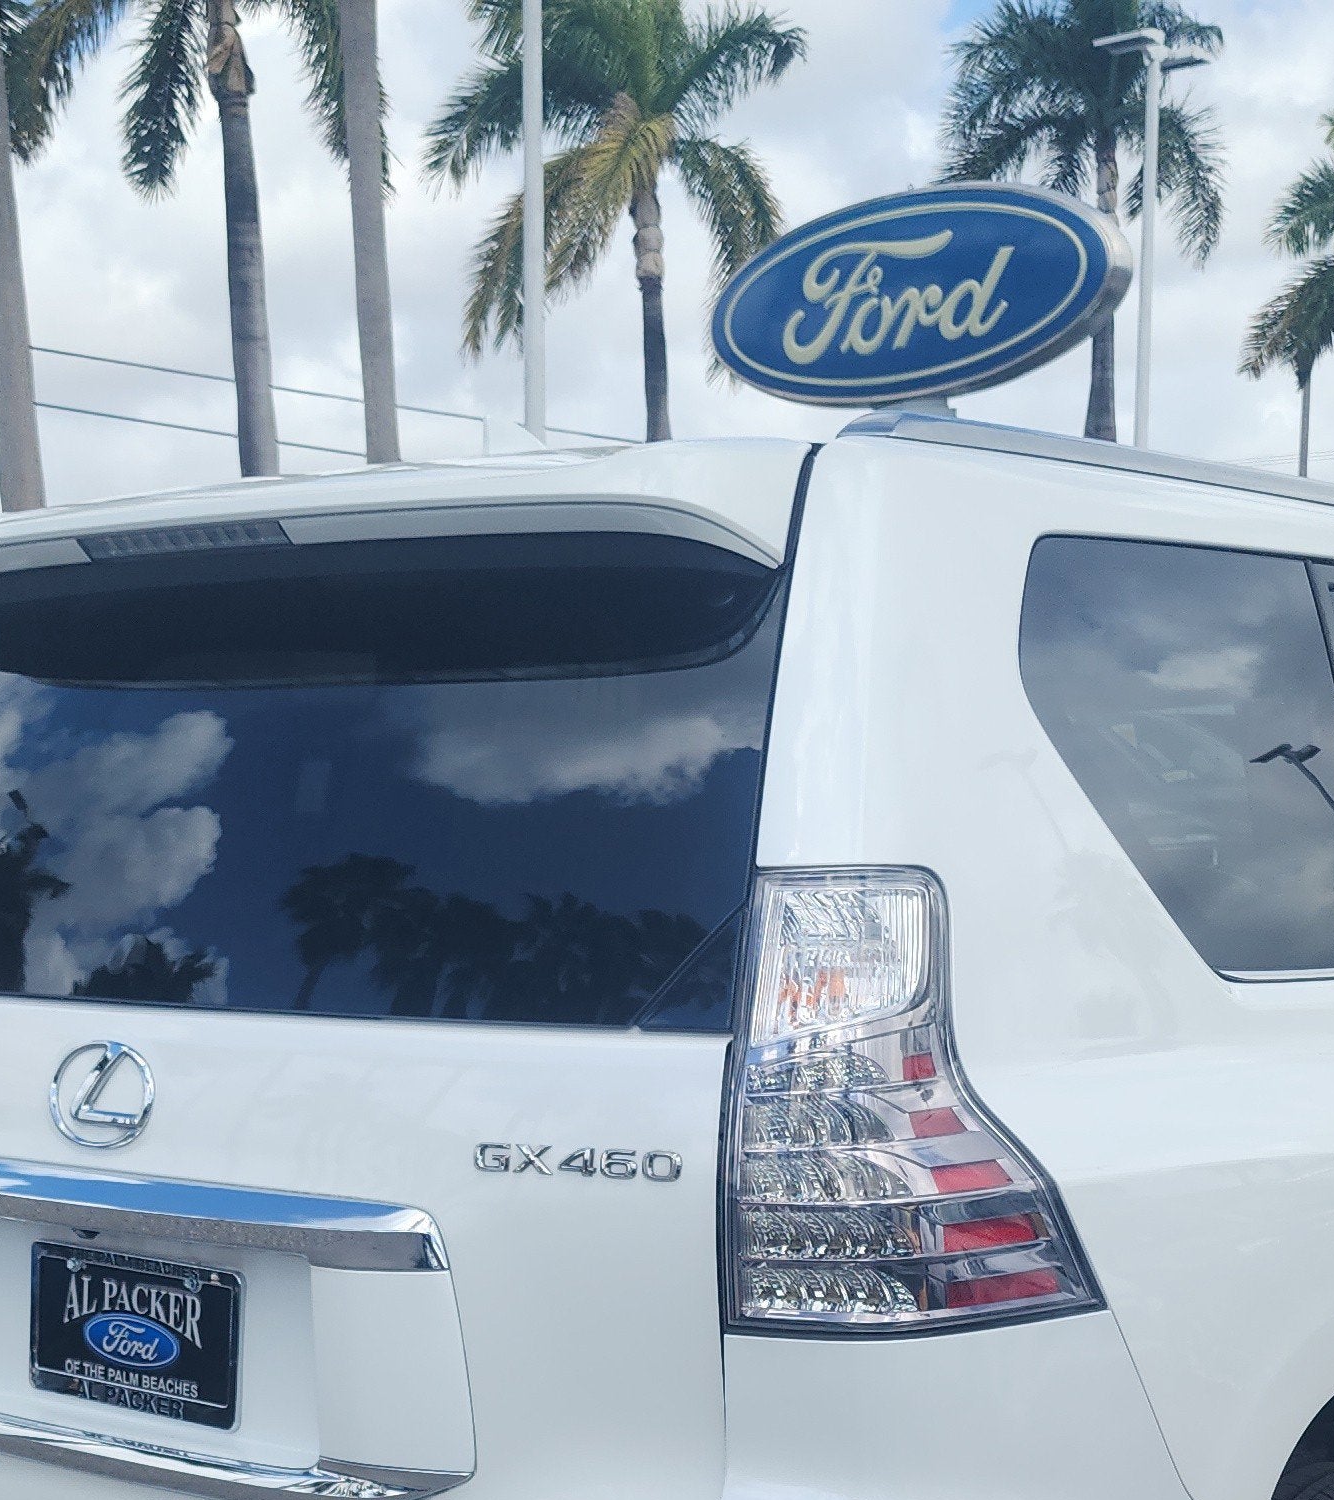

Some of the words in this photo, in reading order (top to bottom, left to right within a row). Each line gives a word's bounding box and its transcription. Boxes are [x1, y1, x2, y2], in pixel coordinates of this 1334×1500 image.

[783, 229, 1015, 365] Ford
[473, 1142, 684, 1183] GX460
[63, 1273, 98, 1324] AL
[101, 1277, 204, 1350] PACKER
[102, 1321, 158, 1362] Ford
[64, 1359, 82, 1375] OF
[84, 1362, 105, 1379] THE
[108, 1367, 139, 1387] PALM
[141, 1375, 199, 1399] BEACHES
[104, 1385, 185, 1420] PACKER
